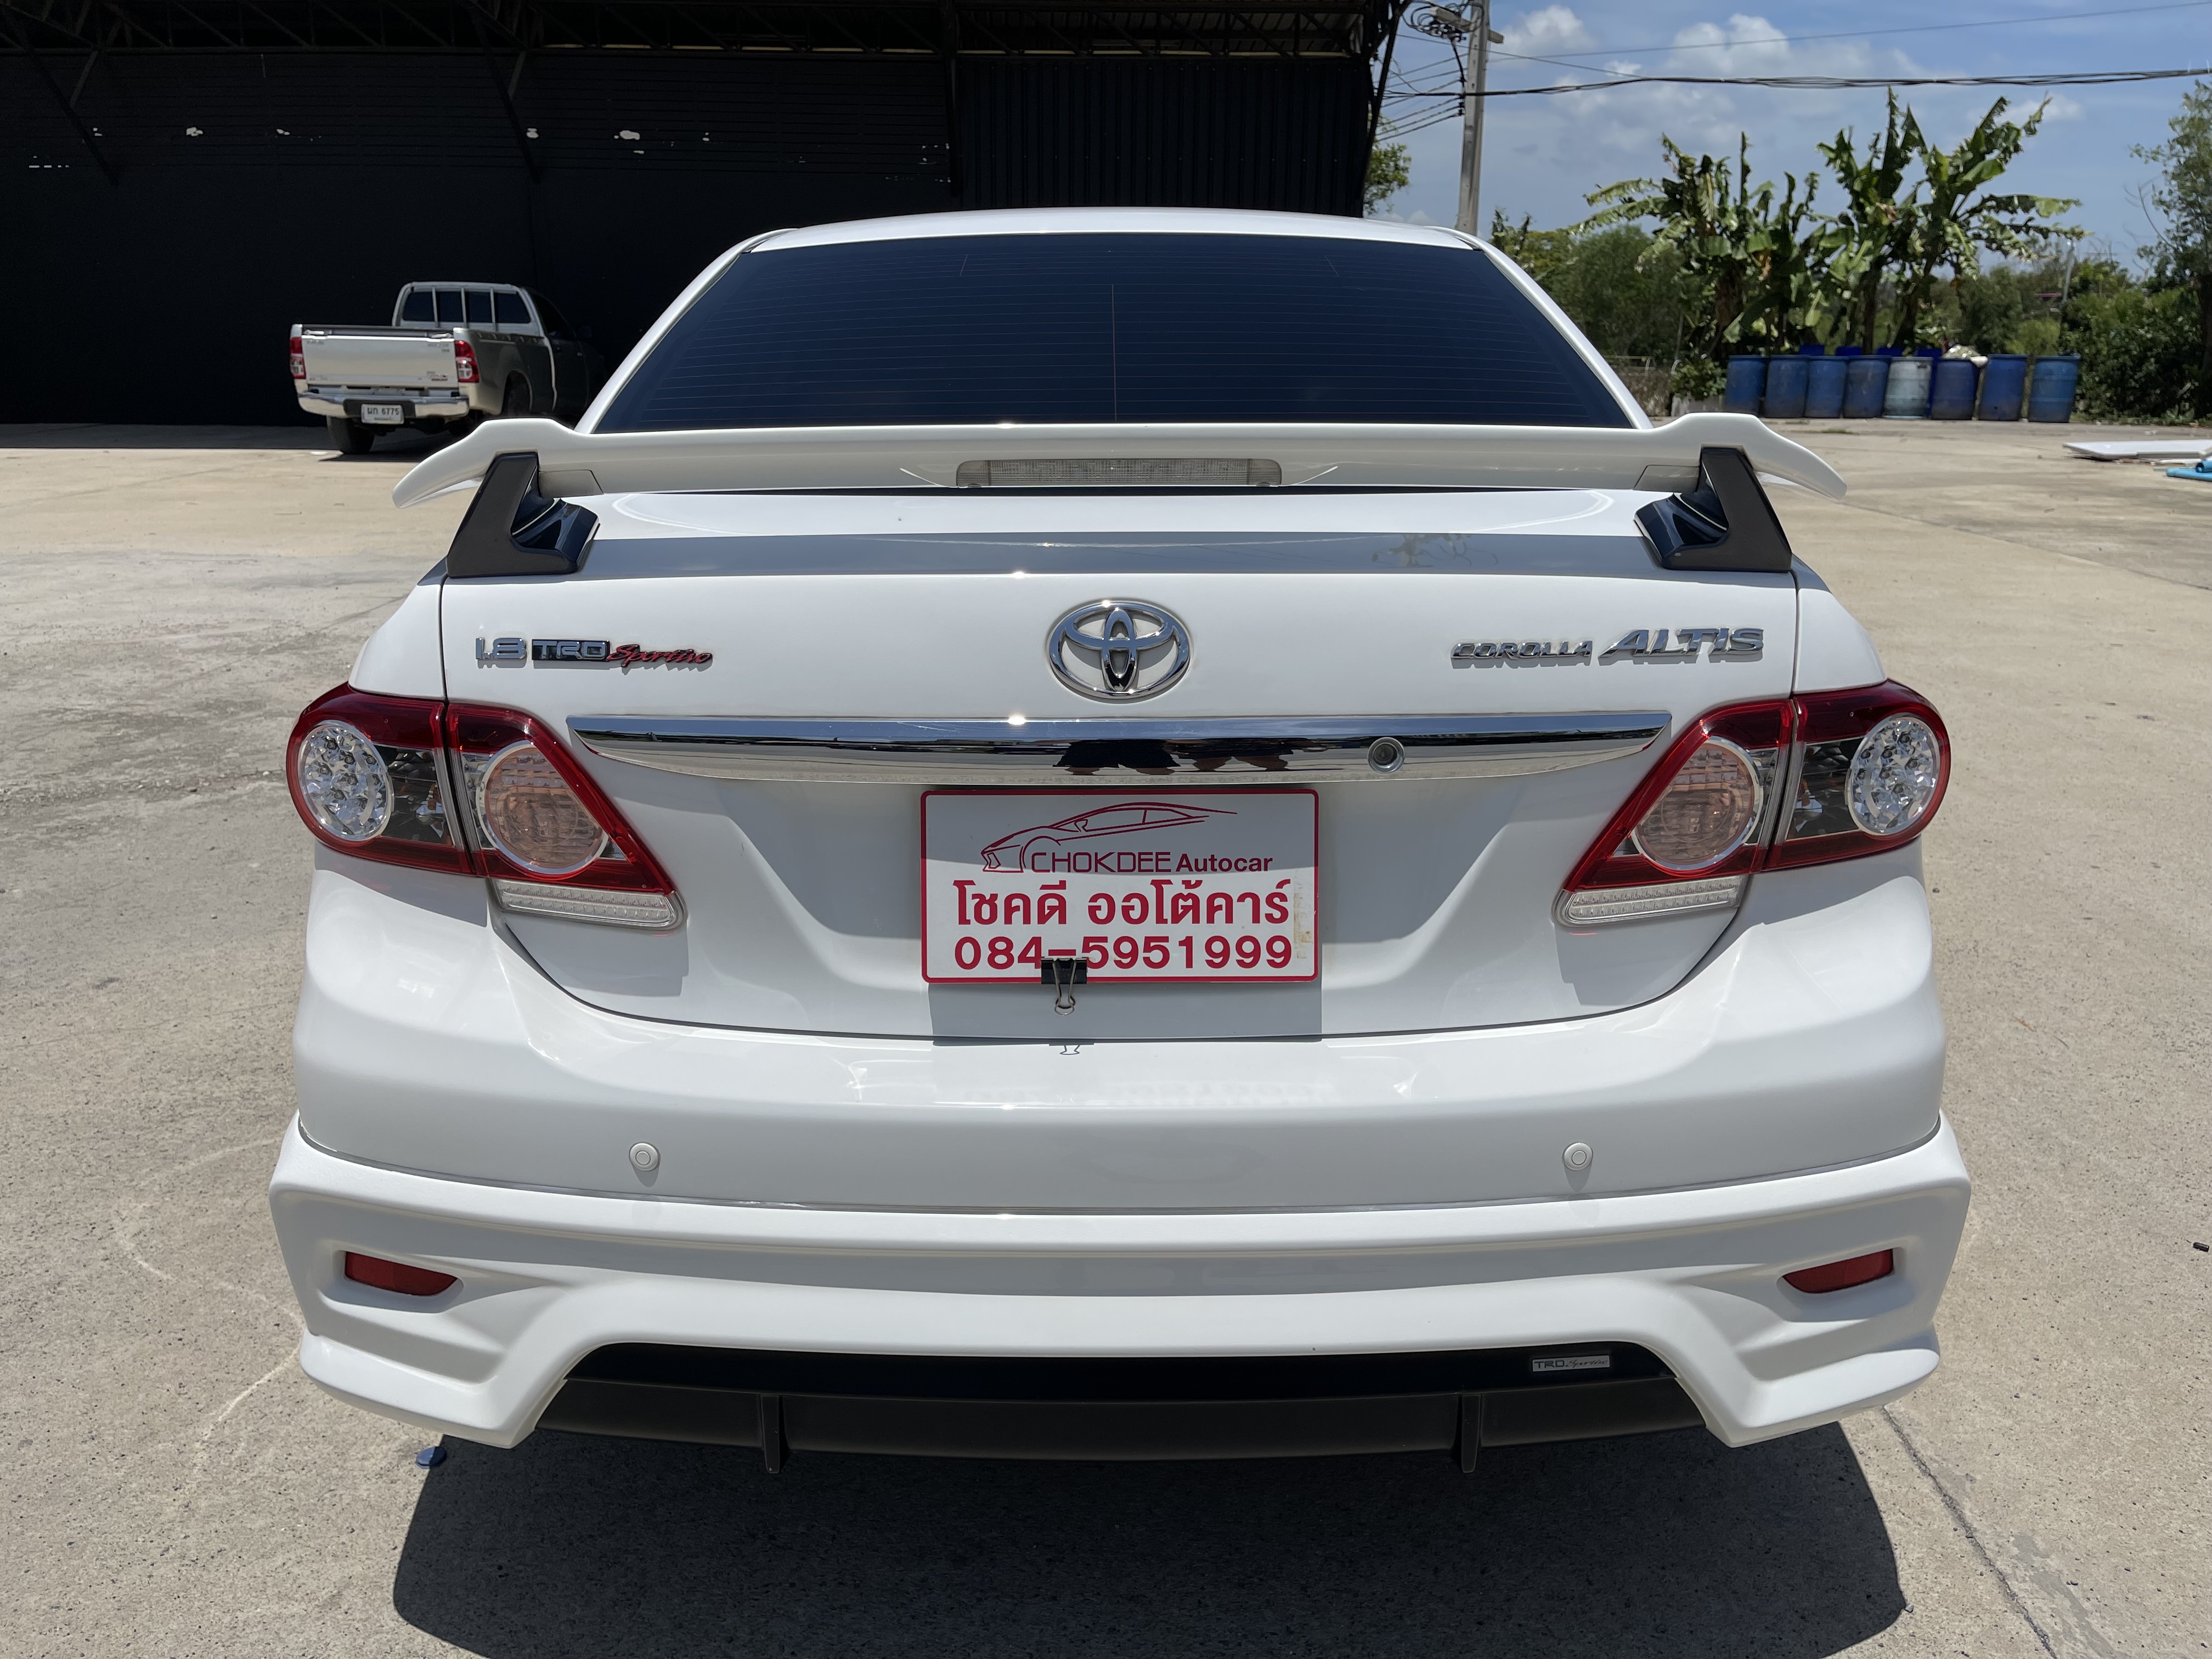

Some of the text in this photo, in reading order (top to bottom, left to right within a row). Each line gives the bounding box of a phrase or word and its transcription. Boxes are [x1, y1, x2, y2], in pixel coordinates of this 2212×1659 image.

[381, 407, 400, 415] 6775
[475, 637, 713, 668] 1.8 TRD Sportivo
[1452, 628, 1764, 659] COROLLA ALTIS
[1031, 851, 1273, 873] CHOKDEE Autocar
[952, 878, 1291, 926] โชคดี ออโต้คาร์
[954, 934, 1293, 970] 084-5951999
[1534, 1359, 1565, 1369] TRD
